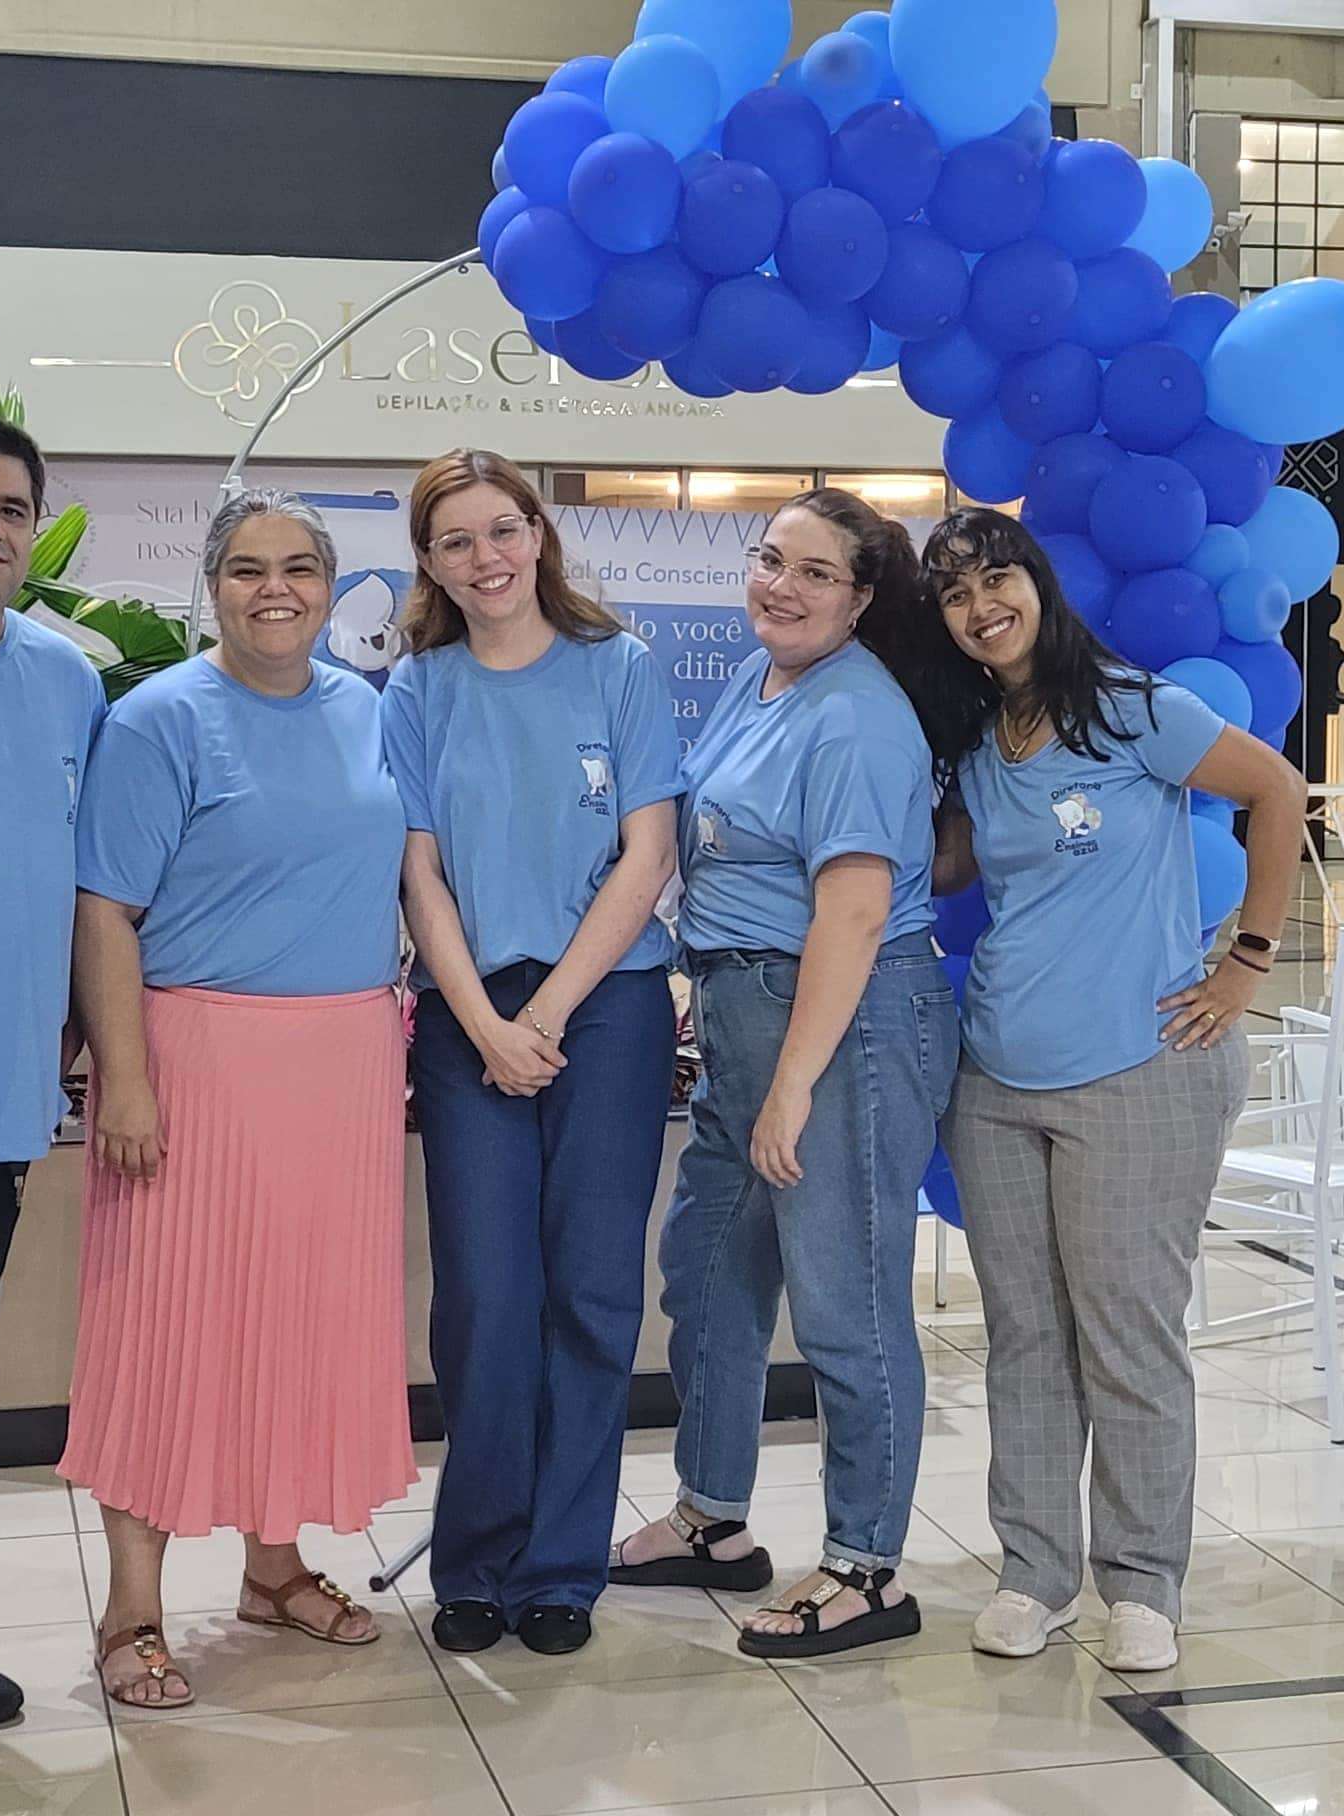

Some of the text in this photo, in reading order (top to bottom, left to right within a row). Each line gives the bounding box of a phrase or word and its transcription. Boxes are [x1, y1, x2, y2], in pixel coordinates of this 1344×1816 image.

[499, 397, 512, 413] &
[136, 501, 183, 524] Sua
[599, 560, 627, 581] da
[635, 562, 746, 585] Conscient
[671, 616, 742, 643] você
